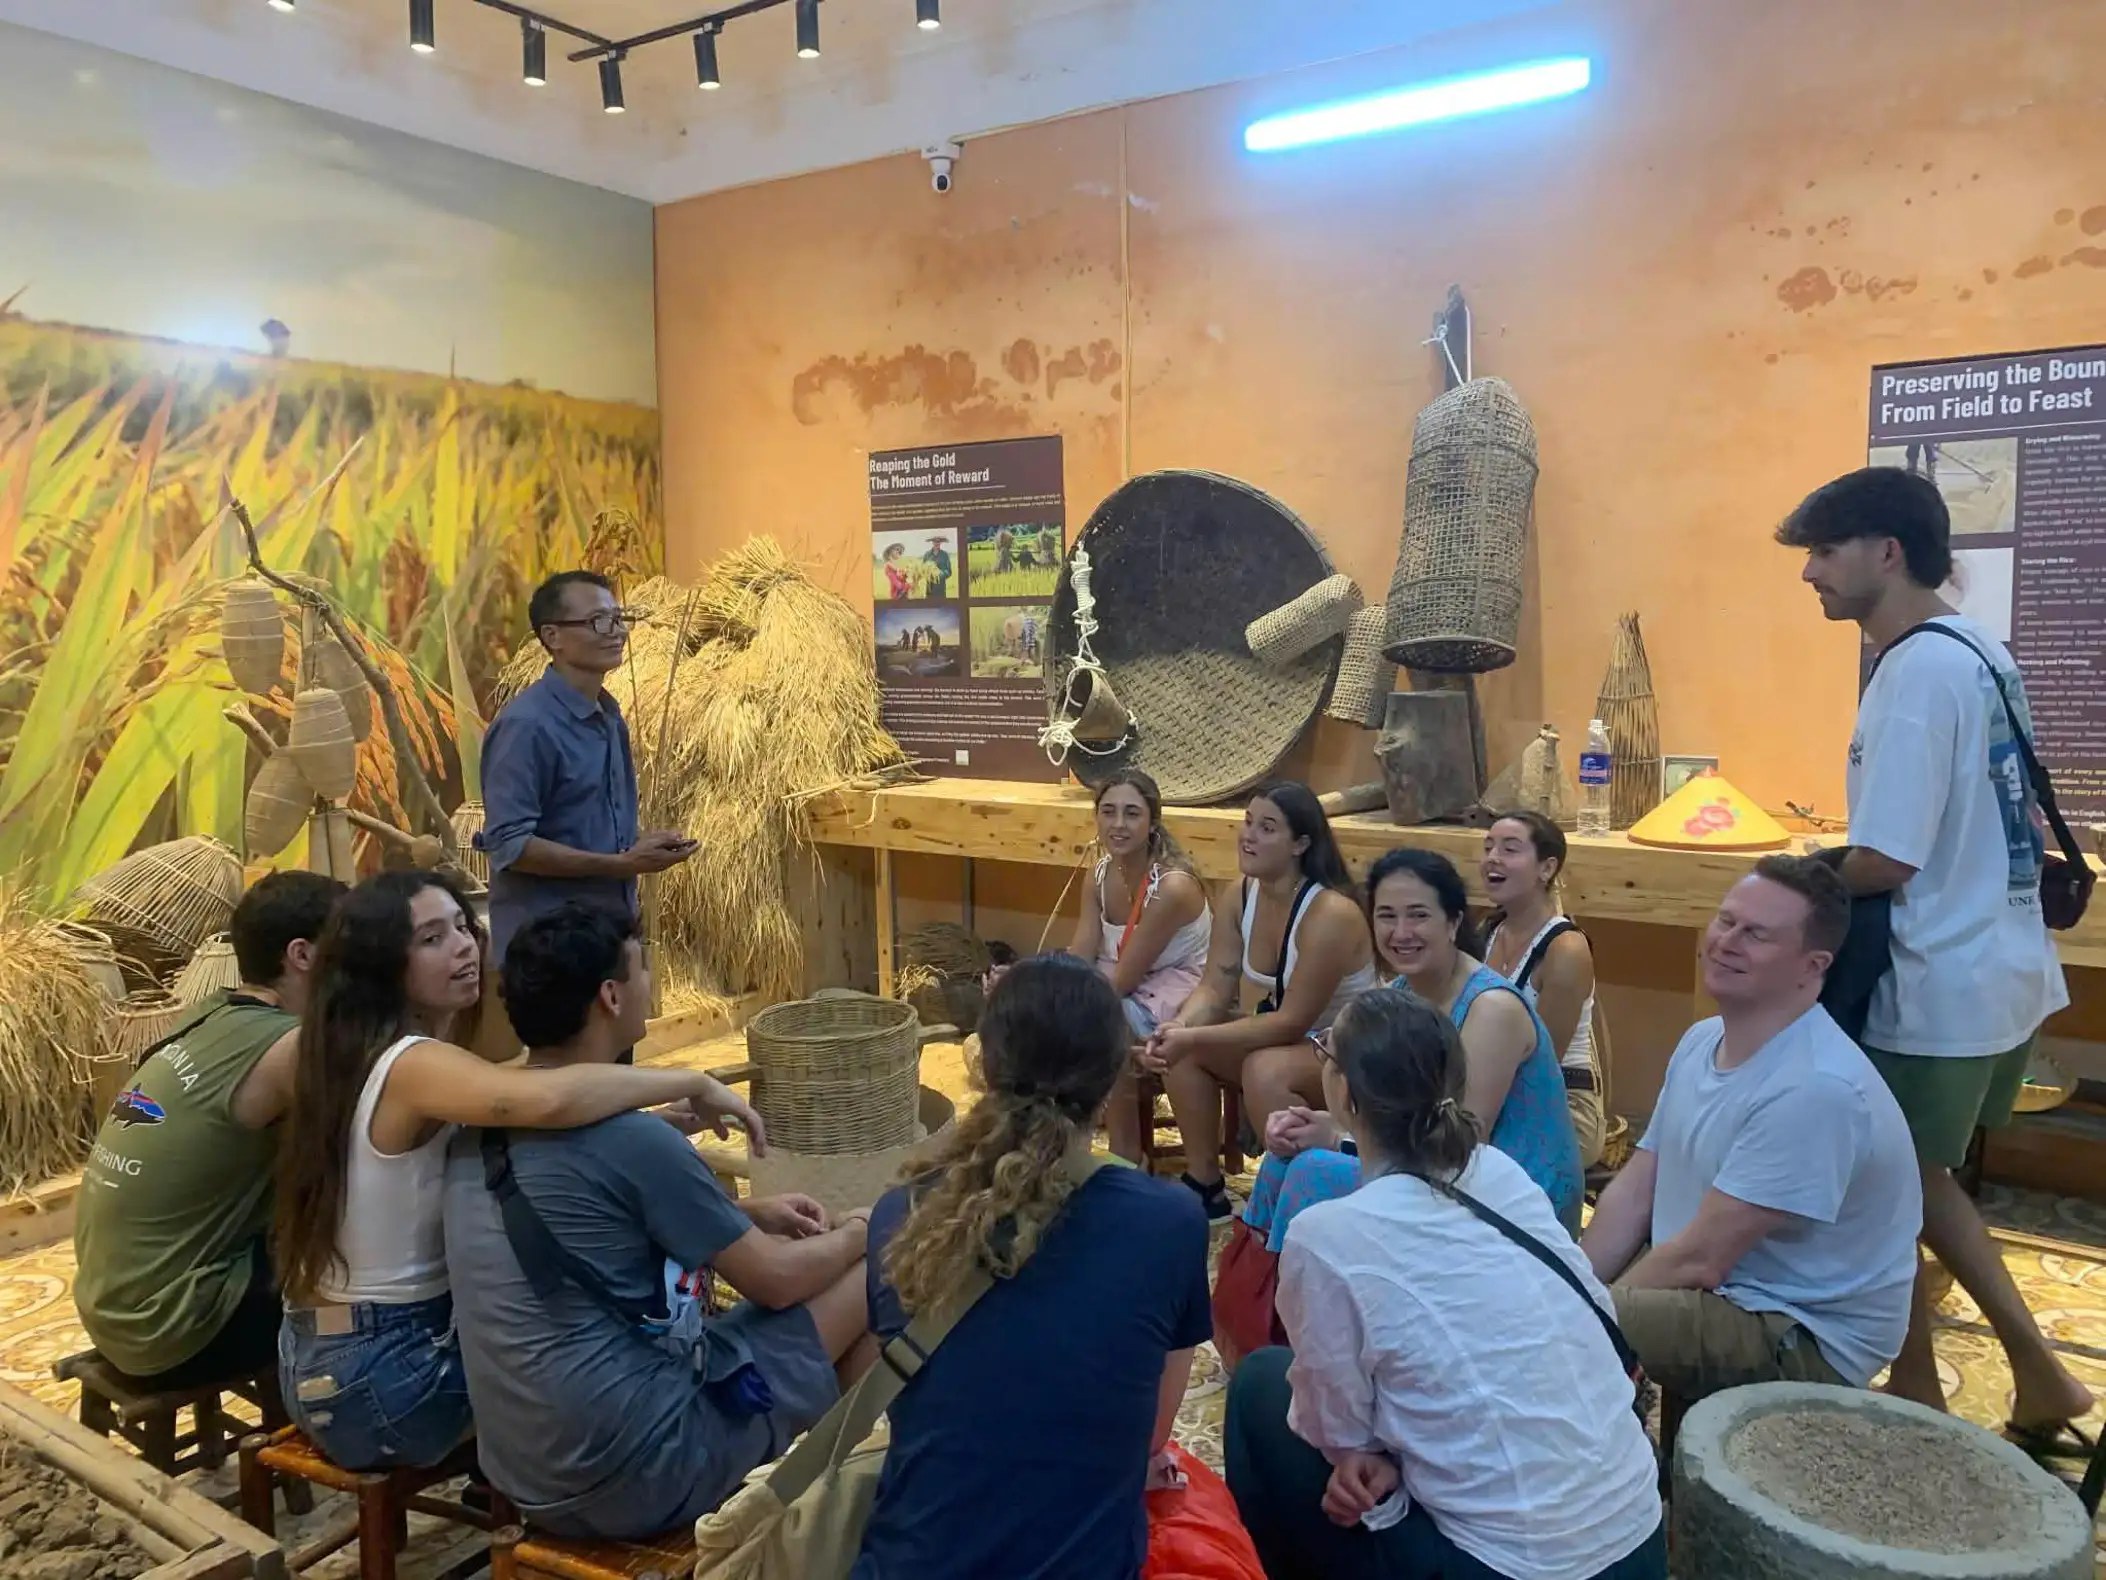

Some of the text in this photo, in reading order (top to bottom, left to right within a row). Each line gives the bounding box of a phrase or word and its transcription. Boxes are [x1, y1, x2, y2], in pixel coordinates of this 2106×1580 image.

[1882, 359, 2106, 396] Preserving the Boun
[1881, 387, 2093, 424] From Field to Feast
[869, 452, 956, 474] Reaping the Gold
[870, 467, 990, 490] The Moment of Reward
